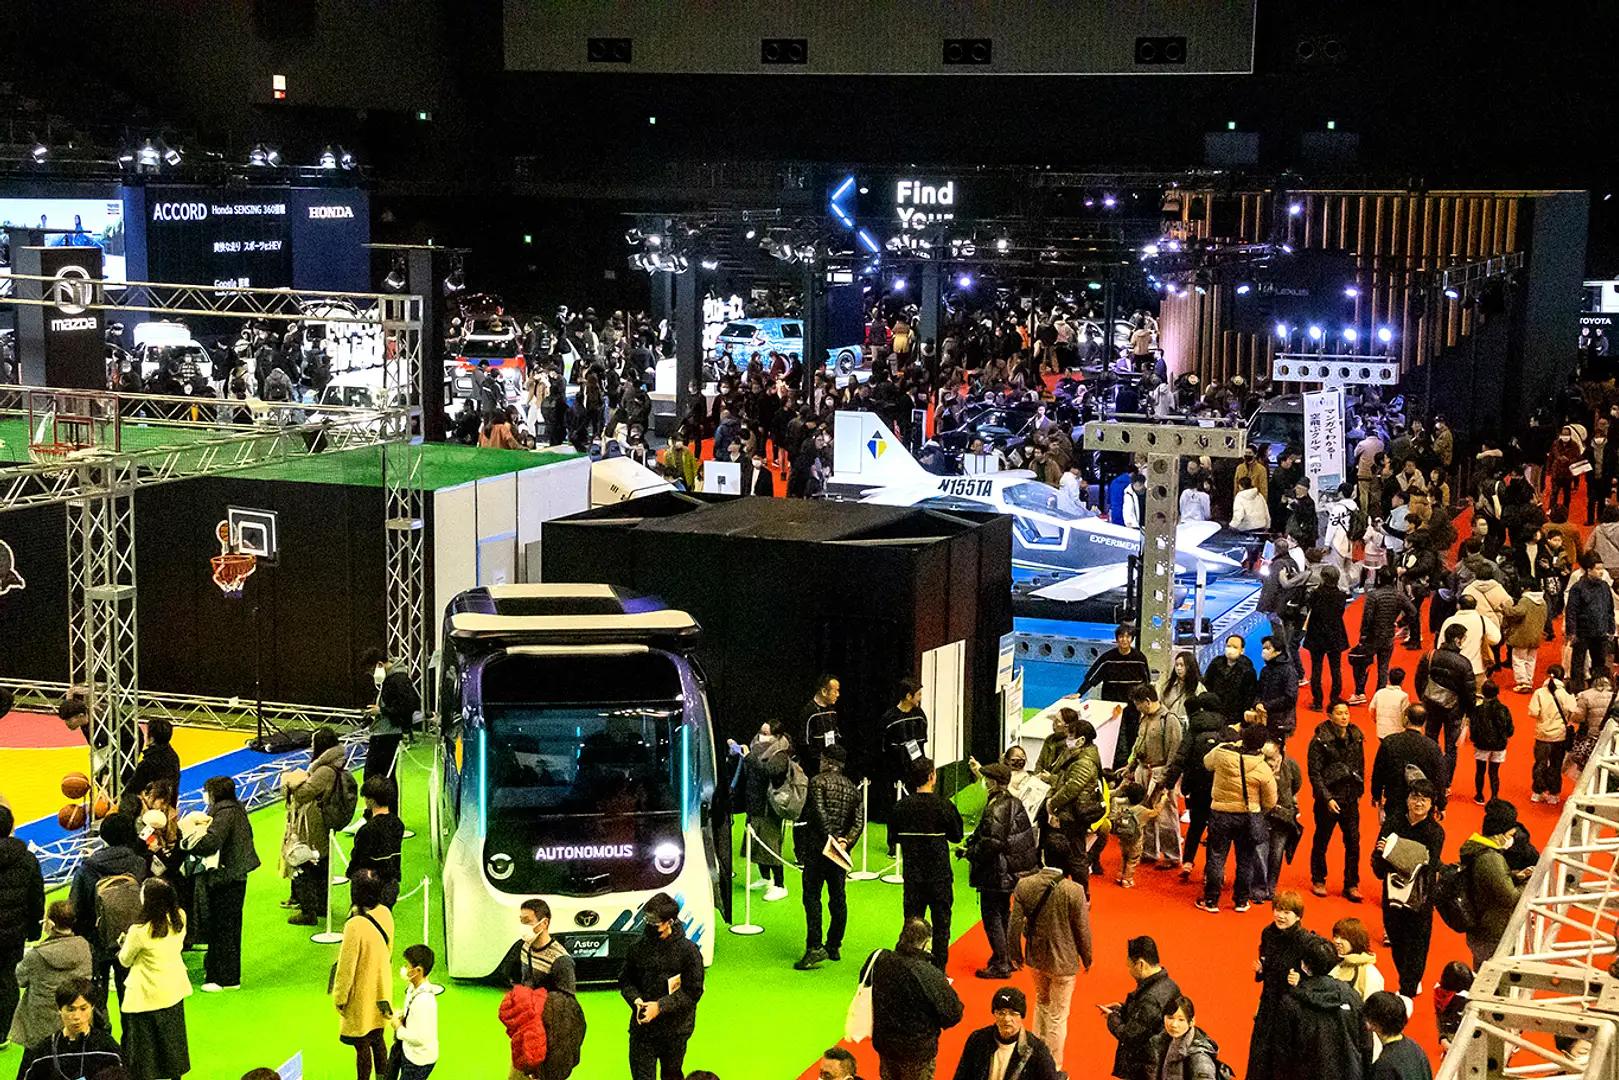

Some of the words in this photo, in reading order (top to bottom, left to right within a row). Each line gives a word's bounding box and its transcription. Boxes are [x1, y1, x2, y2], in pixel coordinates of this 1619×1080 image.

[897, 181, 954, 204] Find
[153, 202, 208, 221] ACCORD
[211, 204, 233, 215] Honda
[234, 204, 262, 215] SENSING
[308, 206, 355, 219] HONDA
[51, 317, 97, 331] mazda
[937, 478, 993, 497] N155TA
[535, 844, 634, 861] AUTONOMOUS
[573, 940, 600, 948] Astro
